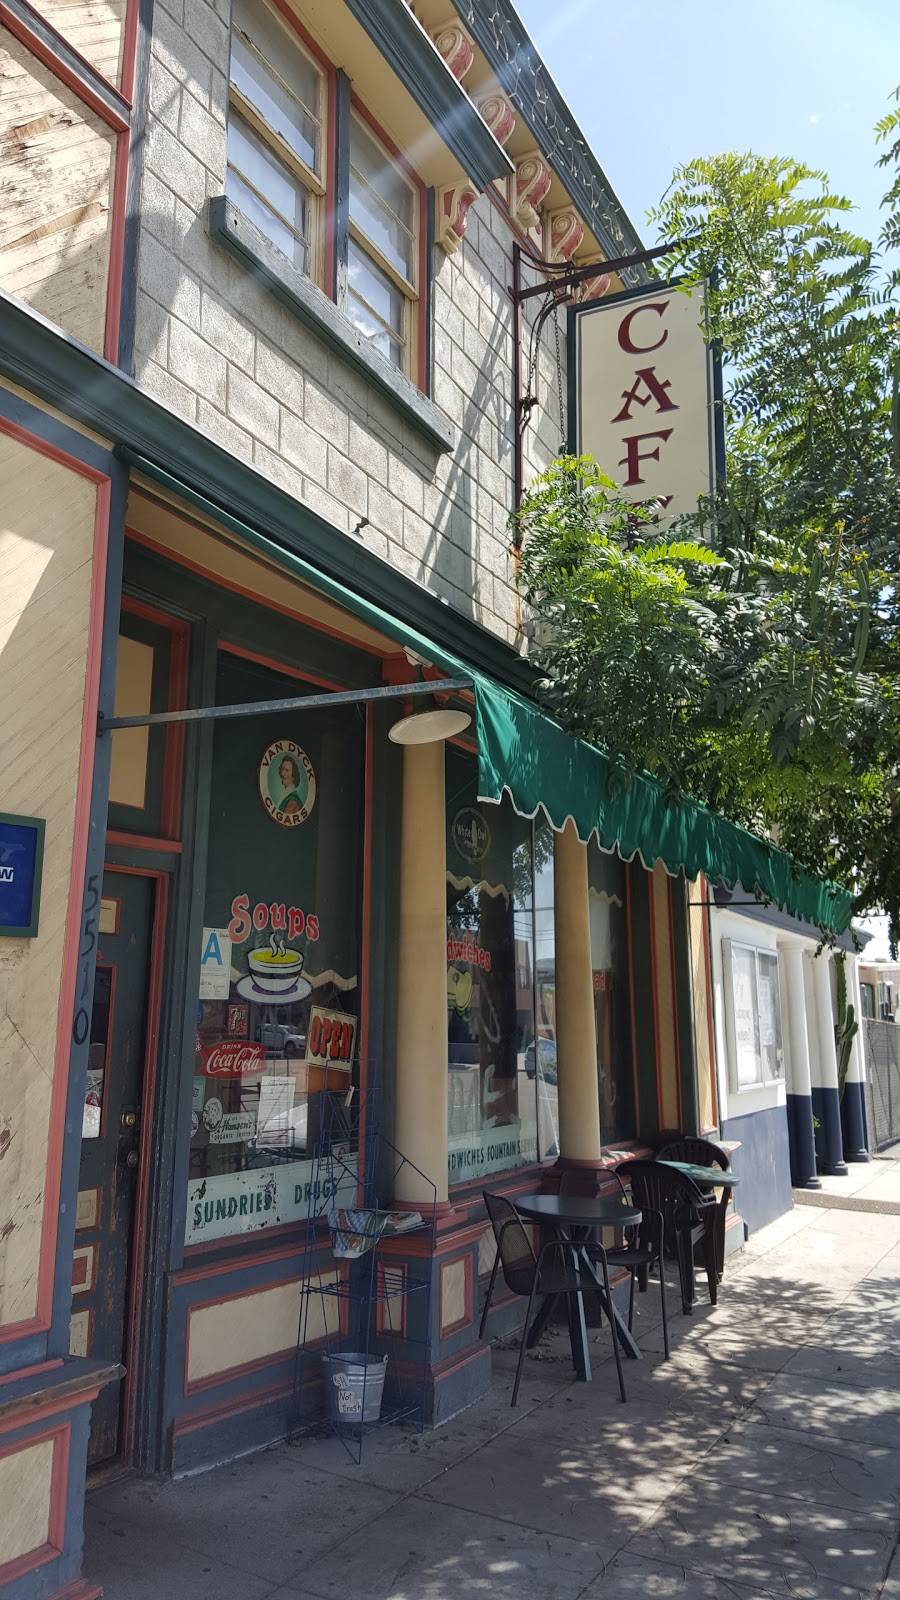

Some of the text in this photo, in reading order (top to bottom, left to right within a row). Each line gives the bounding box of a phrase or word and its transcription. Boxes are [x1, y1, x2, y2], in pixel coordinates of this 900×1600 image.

[262, 742, 315, 782] VAN DYCK
[264, 796, 308, 825] CIGARS
[228, 893, 320, 944] Soups
[201, 931, 223, 966] A
[310, 1015, 355, 1060] OPEN
[206, 1047, 262, 1074] Coca-Cola
[487, 1140, 517, 1162] FOUNTAIN
[193, 1177, 338, 1226] SUNDRIES DRUGS
